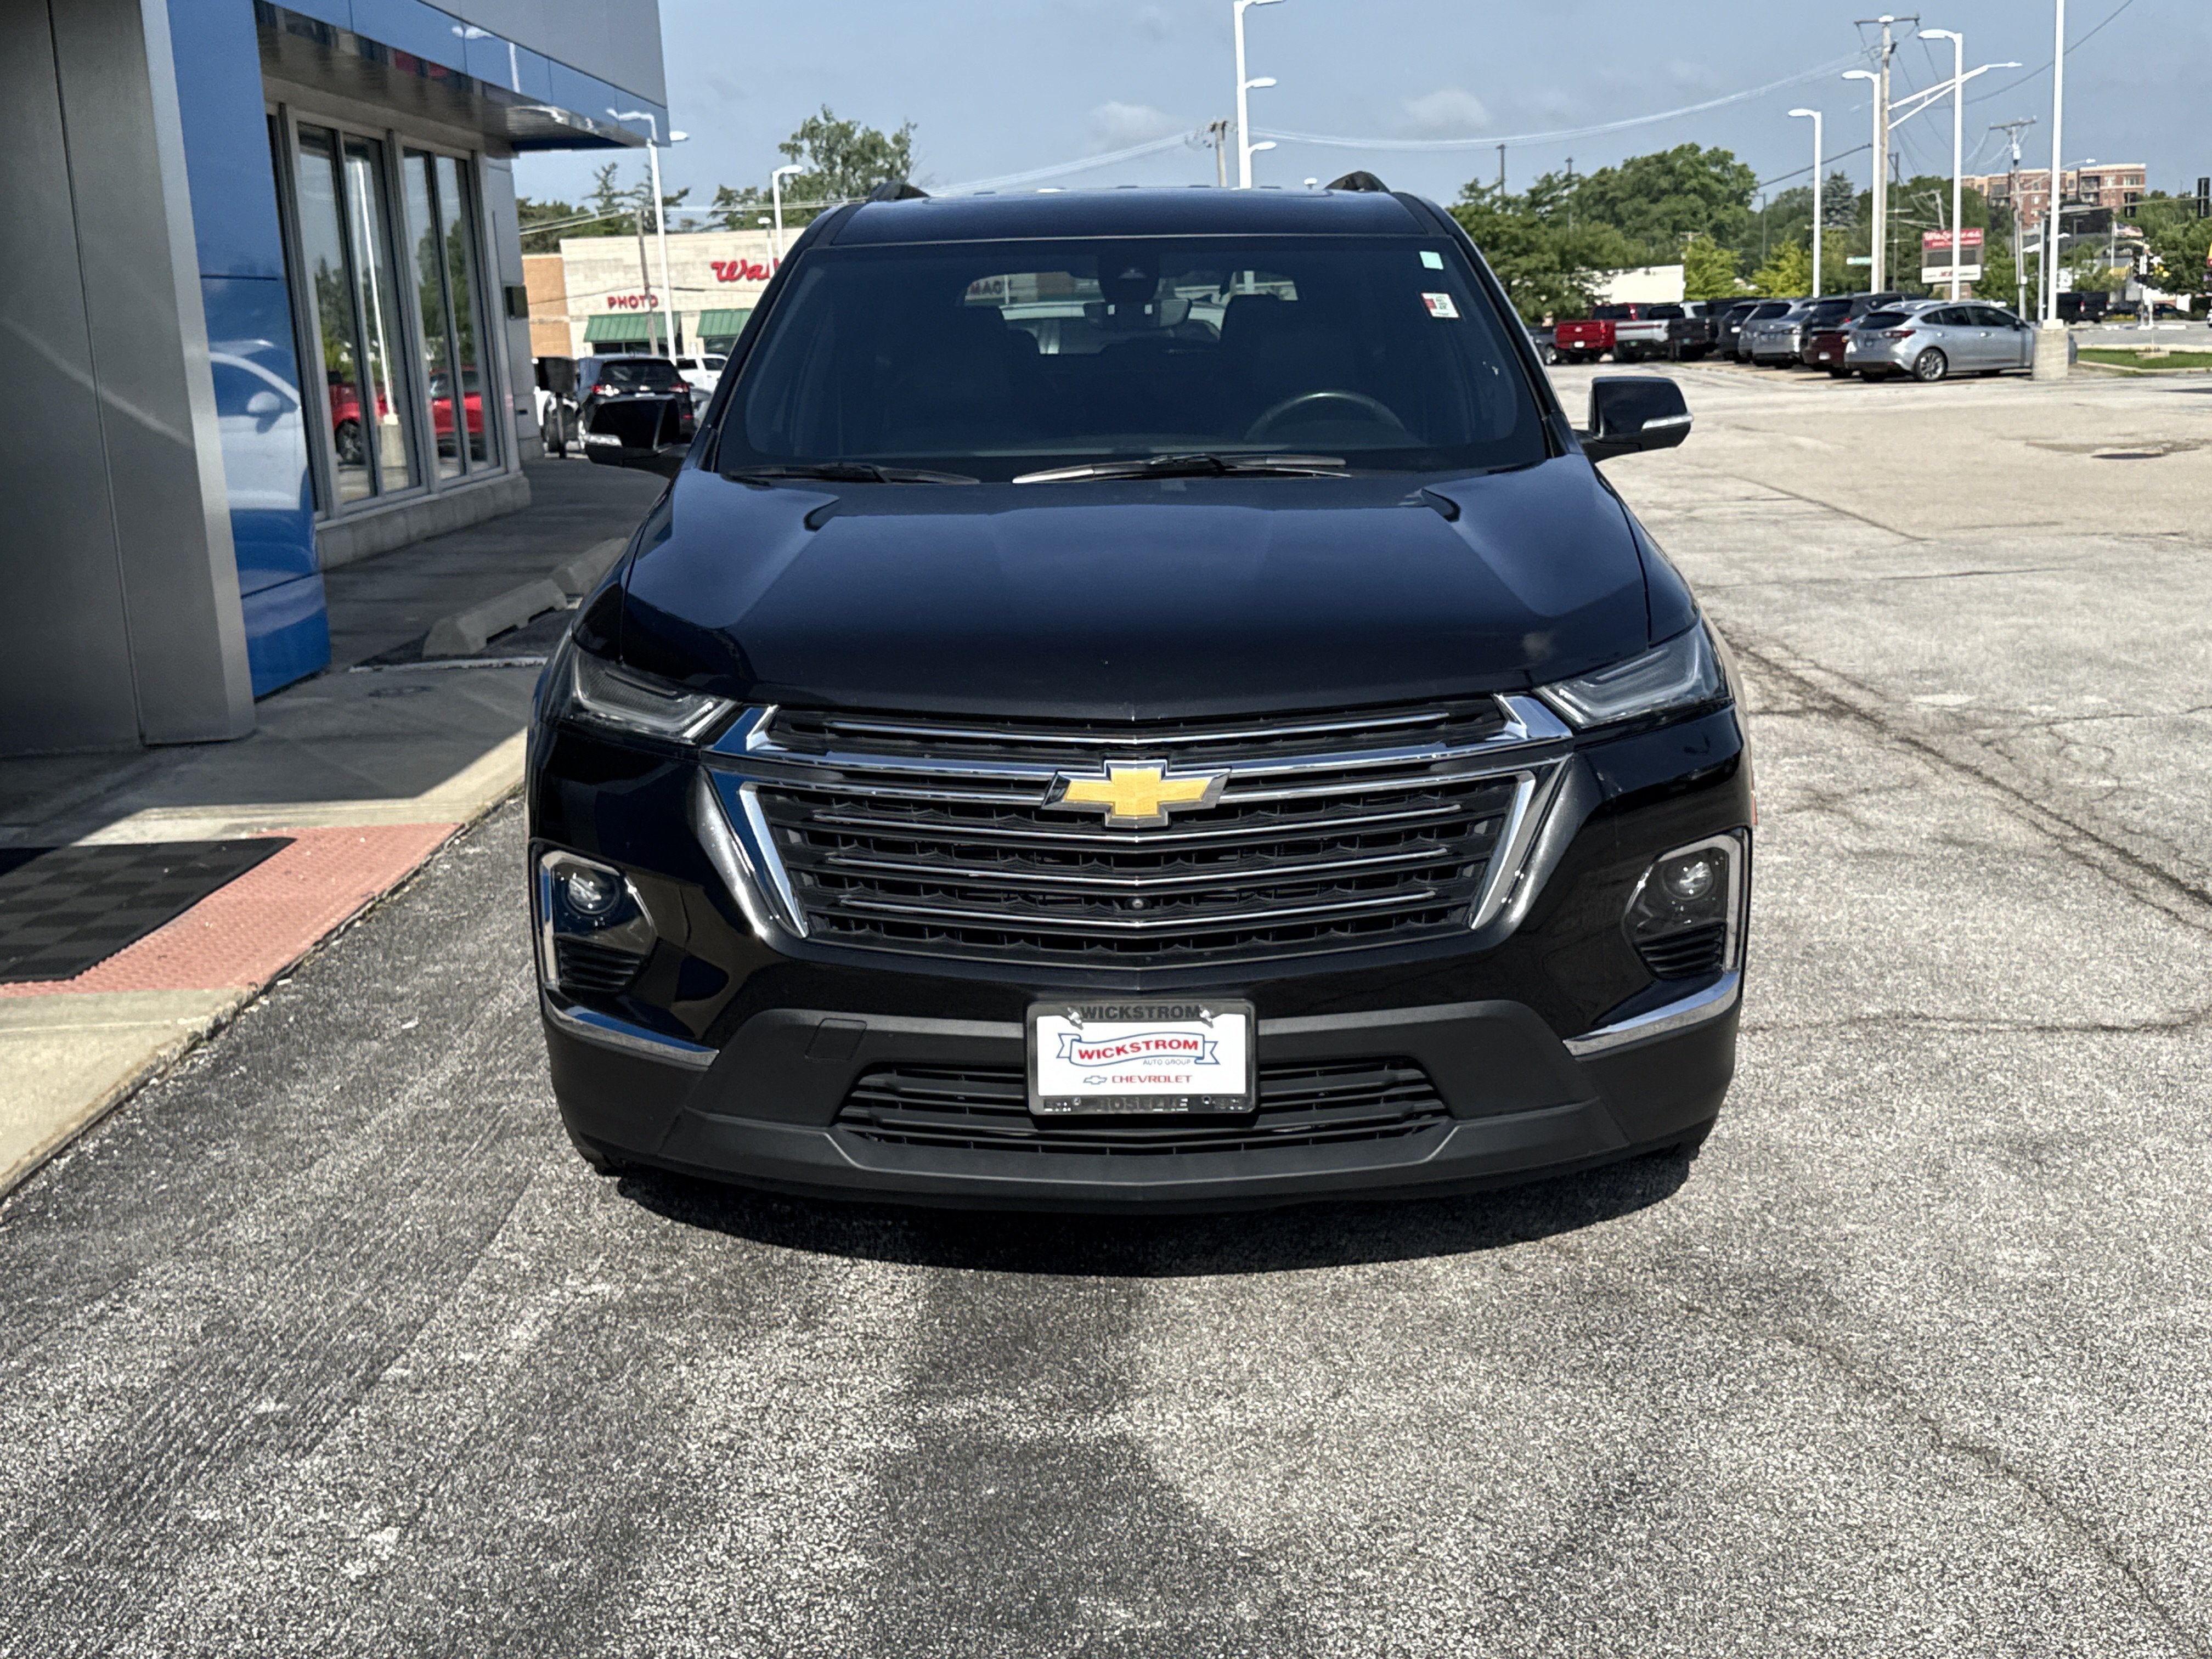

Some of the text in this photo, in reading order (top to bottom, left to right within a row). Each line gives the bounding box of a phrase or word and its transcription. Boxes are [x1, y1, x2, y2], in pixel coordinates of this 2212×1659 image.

[607, 295, 659, 309] PHOTO
[1080, 1005, 1200, 1020] WICKSTROM
[1077, 1039, 1199, 1060] WICKSTROM
[1111, 1075, 1193, 1084] CHEVROLET
